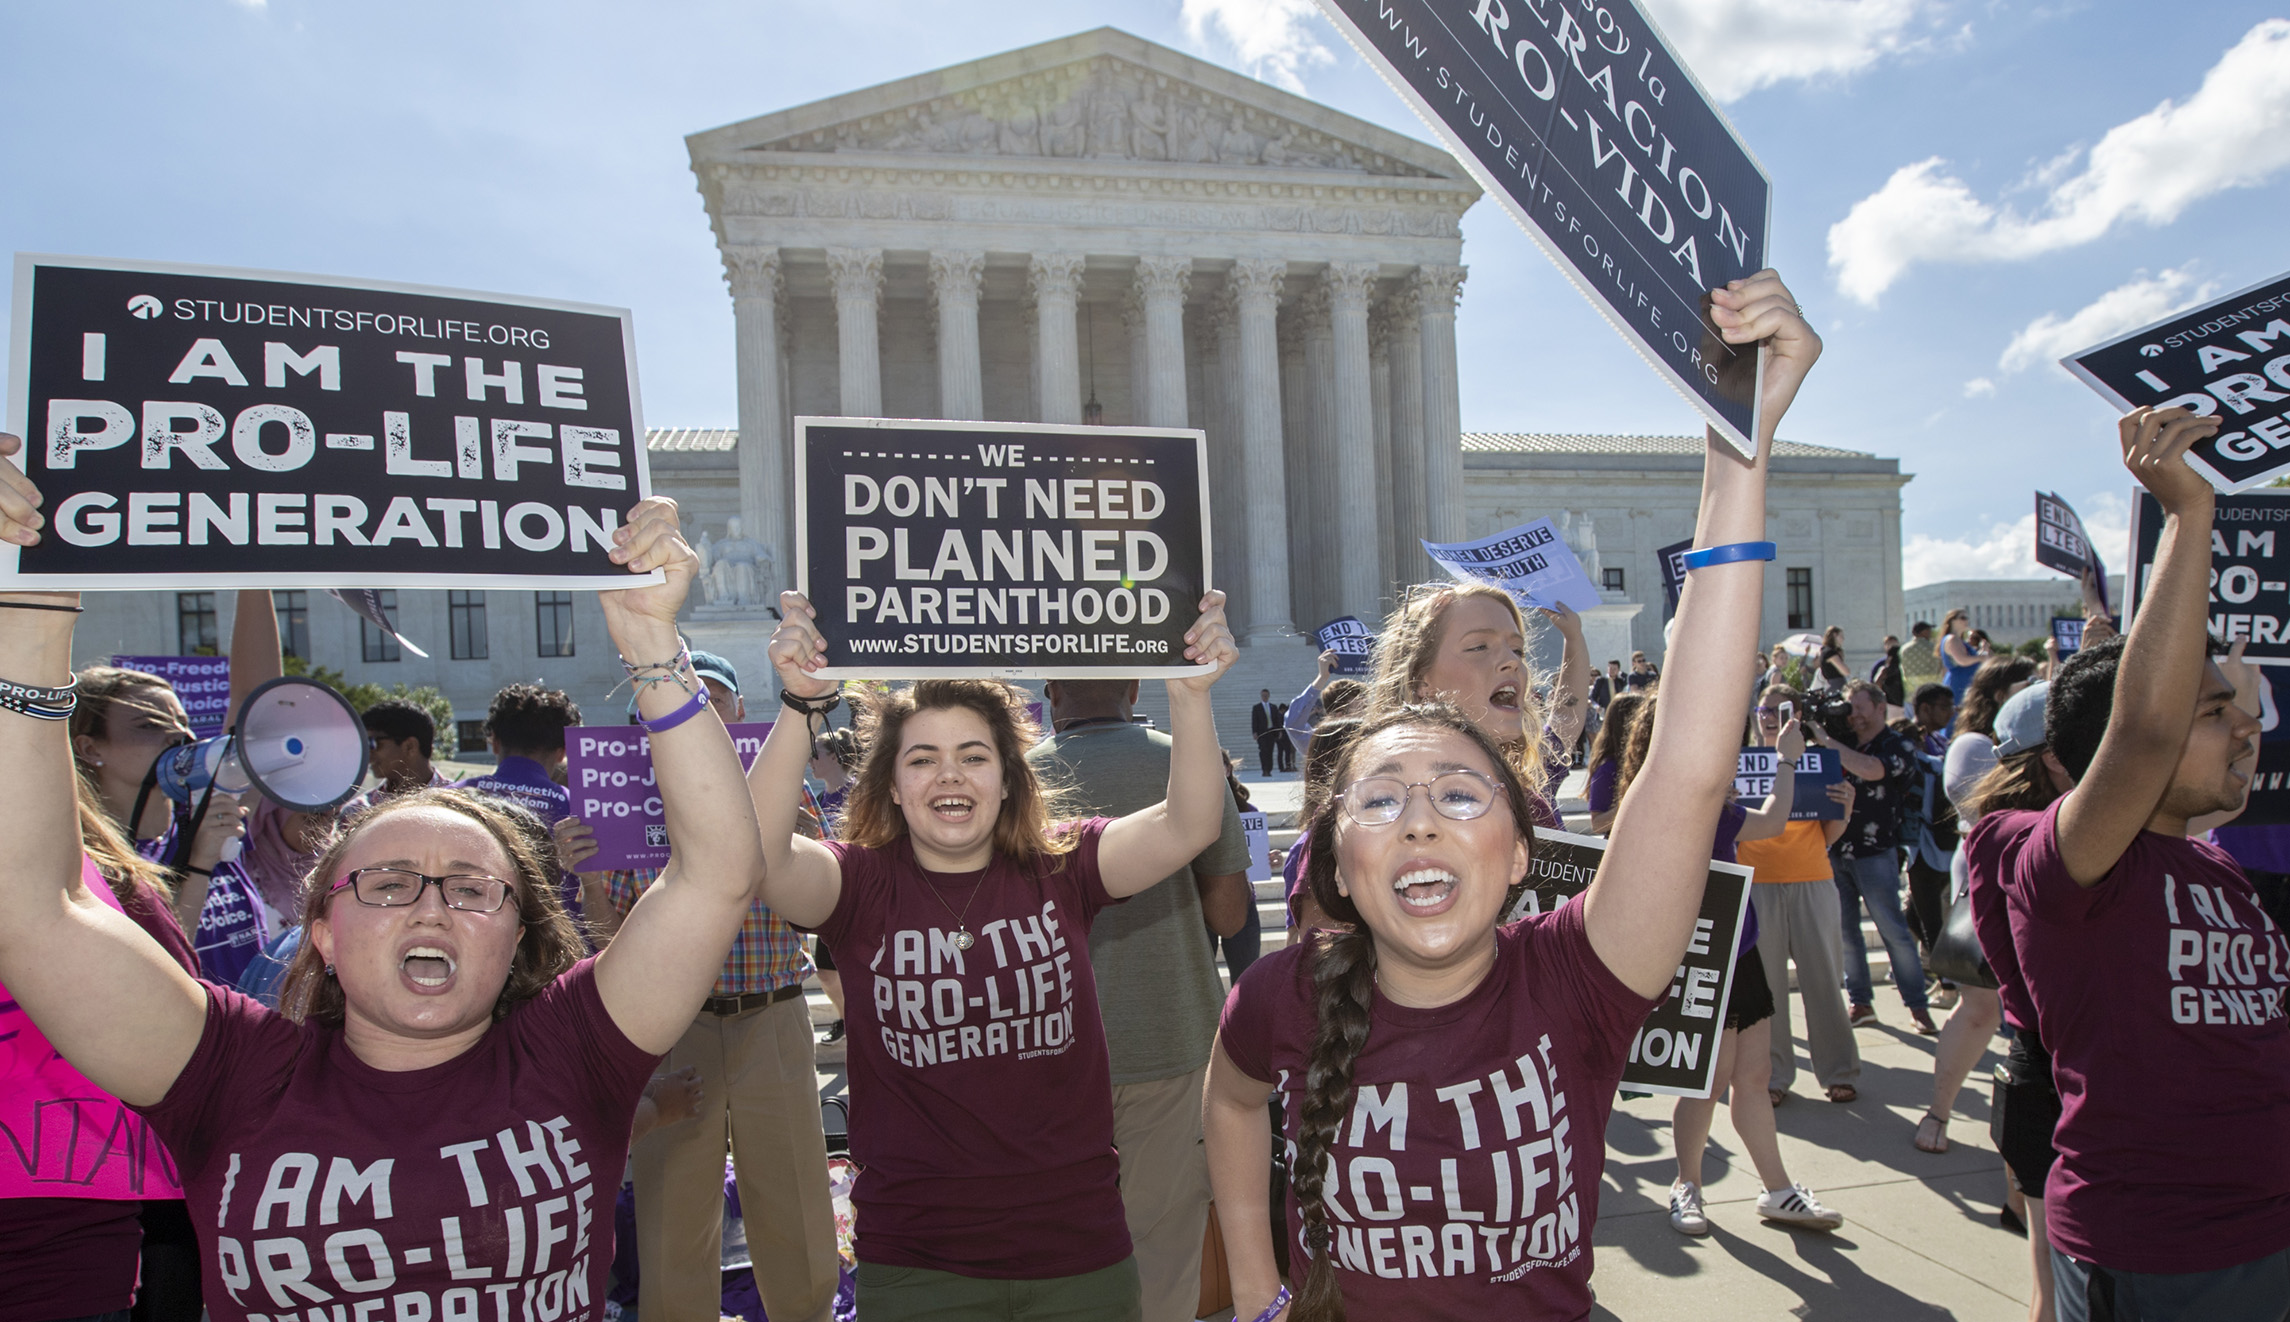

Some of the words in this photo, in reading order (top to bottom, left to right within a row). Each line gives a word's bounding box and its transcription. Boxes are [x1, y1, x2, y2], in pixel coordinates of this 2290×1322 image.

[1638, 47, 1667, 107] la
[1364, 0, 1719, 385] WW.STUDENTSFORLIFE.ORG
[173, 298, 551, 350] STUDENTSFORLIFE.ORG
[81, 332, 106, 382] I
[168, 337, 341, 392] AM
[395, 349, 589, 411] THE
[2135, 368, 2171, 393] I
[45, 398, 628, 490] PRO-LIFE
[978, 444, 1026, 468] WE
[2214, 411, 2290, 462] GE
[844, 473, 1008, 519] DON'T
[1024, 478, 1166, 520] NEED
[53, 491, 618, 554] GENERATION
[1480, 527, 1553, 562] DESERVE
[2043, 524, 2085, 557] LIES
[845, 525, 1170, 582] PLANNED
[1496, 554, 1546, 580] TRUTH
[846, 585, 1171, 626] PARENTHOOD
[1321, 622, 1352, 640] END
[849, 633, 1169, 655] WWW.STUDENTSFORLIFE.ORG
[0, 681, 74, 701] PRO-LIFE
[476, 780, 566, 802] Reproductive
[584, 796, 663, 818] Pro-C
[870, 933, 886, 972] I
[894, 927, 966, 976] AM
[981, 900, 1066, 969] THE
[873, 950, 1073, 1030] PRO-LIFE
[881, 1001, 1074, 1068] GENERATION
[1435, 1033, 1567, 1151] THE
[218, 1153, 241, 1229] I
[252, 1152, 396, 1231] AM
[438, 1114, 592, 1208] THE
[218, 1182, 595, 1309] PRO-LIFE
